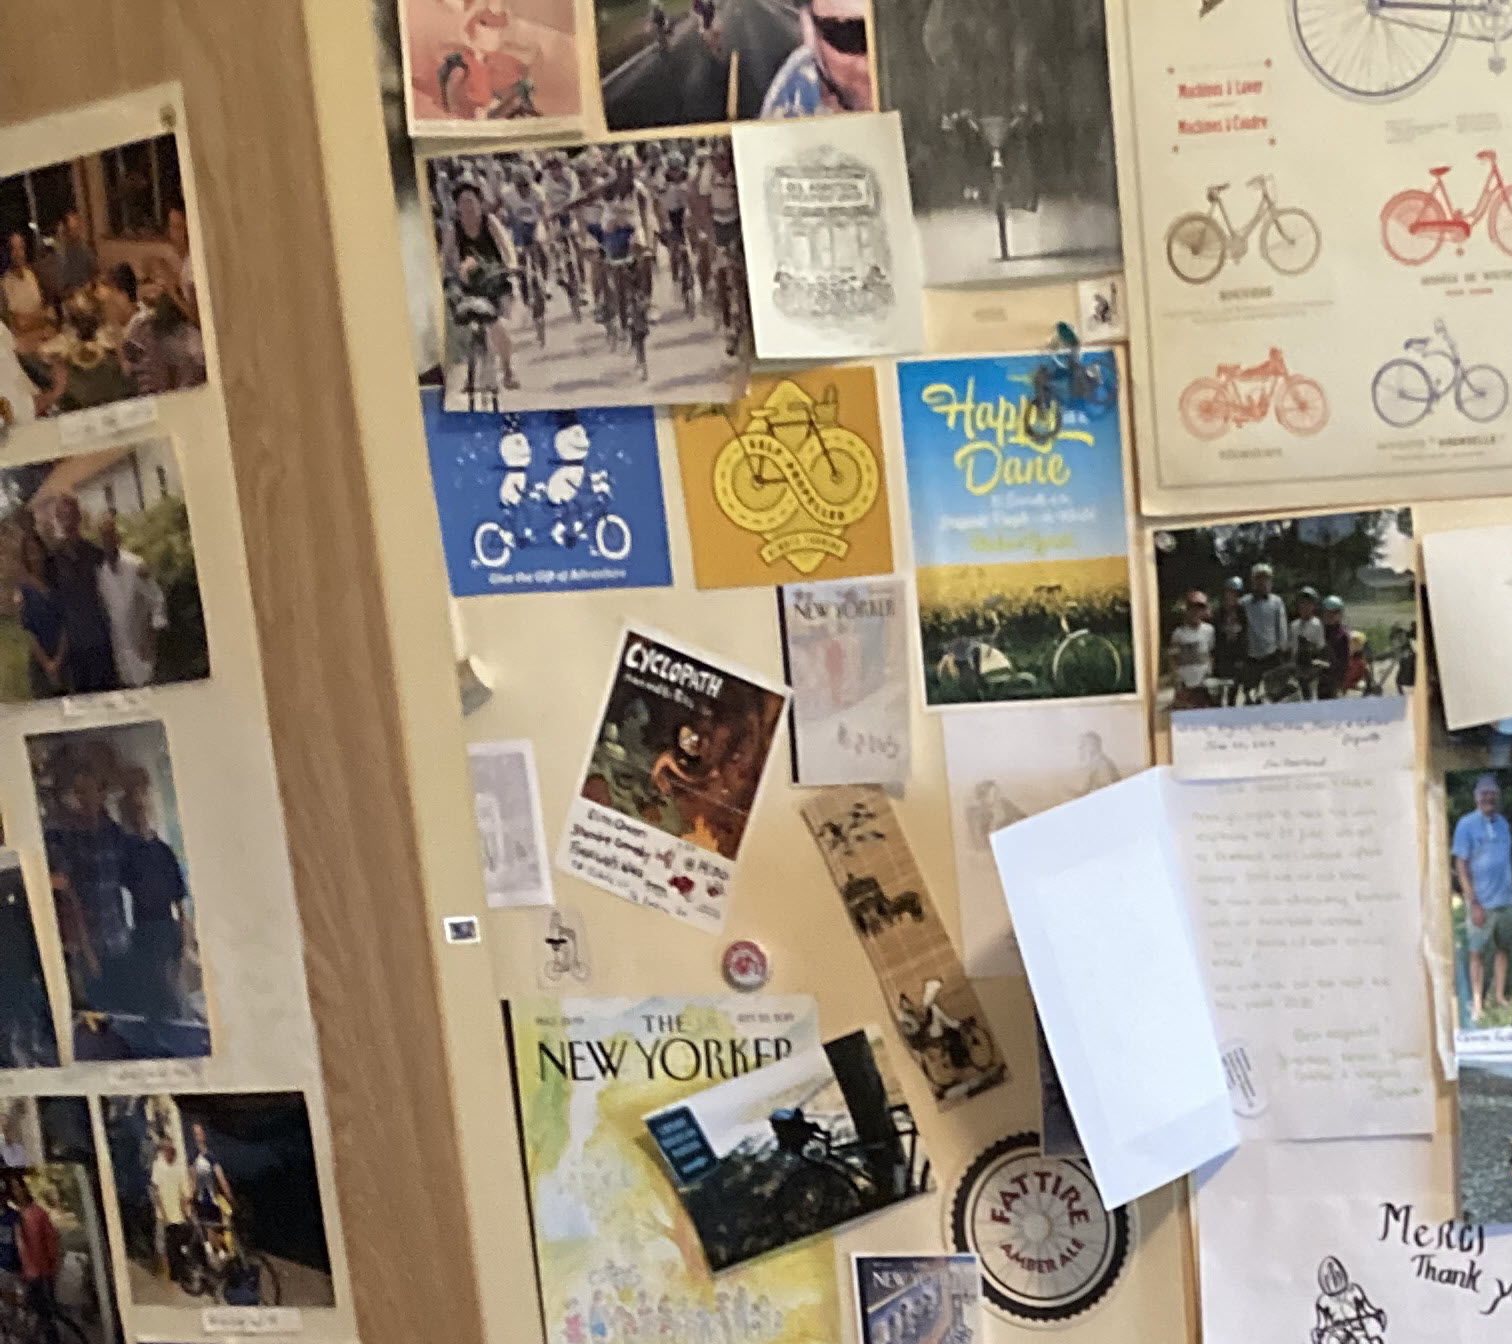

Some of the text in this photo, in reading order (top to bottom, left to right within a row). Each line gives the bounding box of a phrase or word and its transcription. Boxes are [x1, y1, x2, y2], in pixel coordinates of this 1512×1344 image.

[954, 441, 1071, 495] Dane
[625, 642, 724, 699] CYCLOPATH
[641, 1013, 687, 1033] THE
[537, 1038, 628, 1082] NEW
[990, 1173, 1029, 1226] FAT
[1032, 1170, 1090, 1229] TIRE
[1001, 1238, 1086, 1274] AMBER ALE
[1410, 1253, 1483, 1293] Thank
